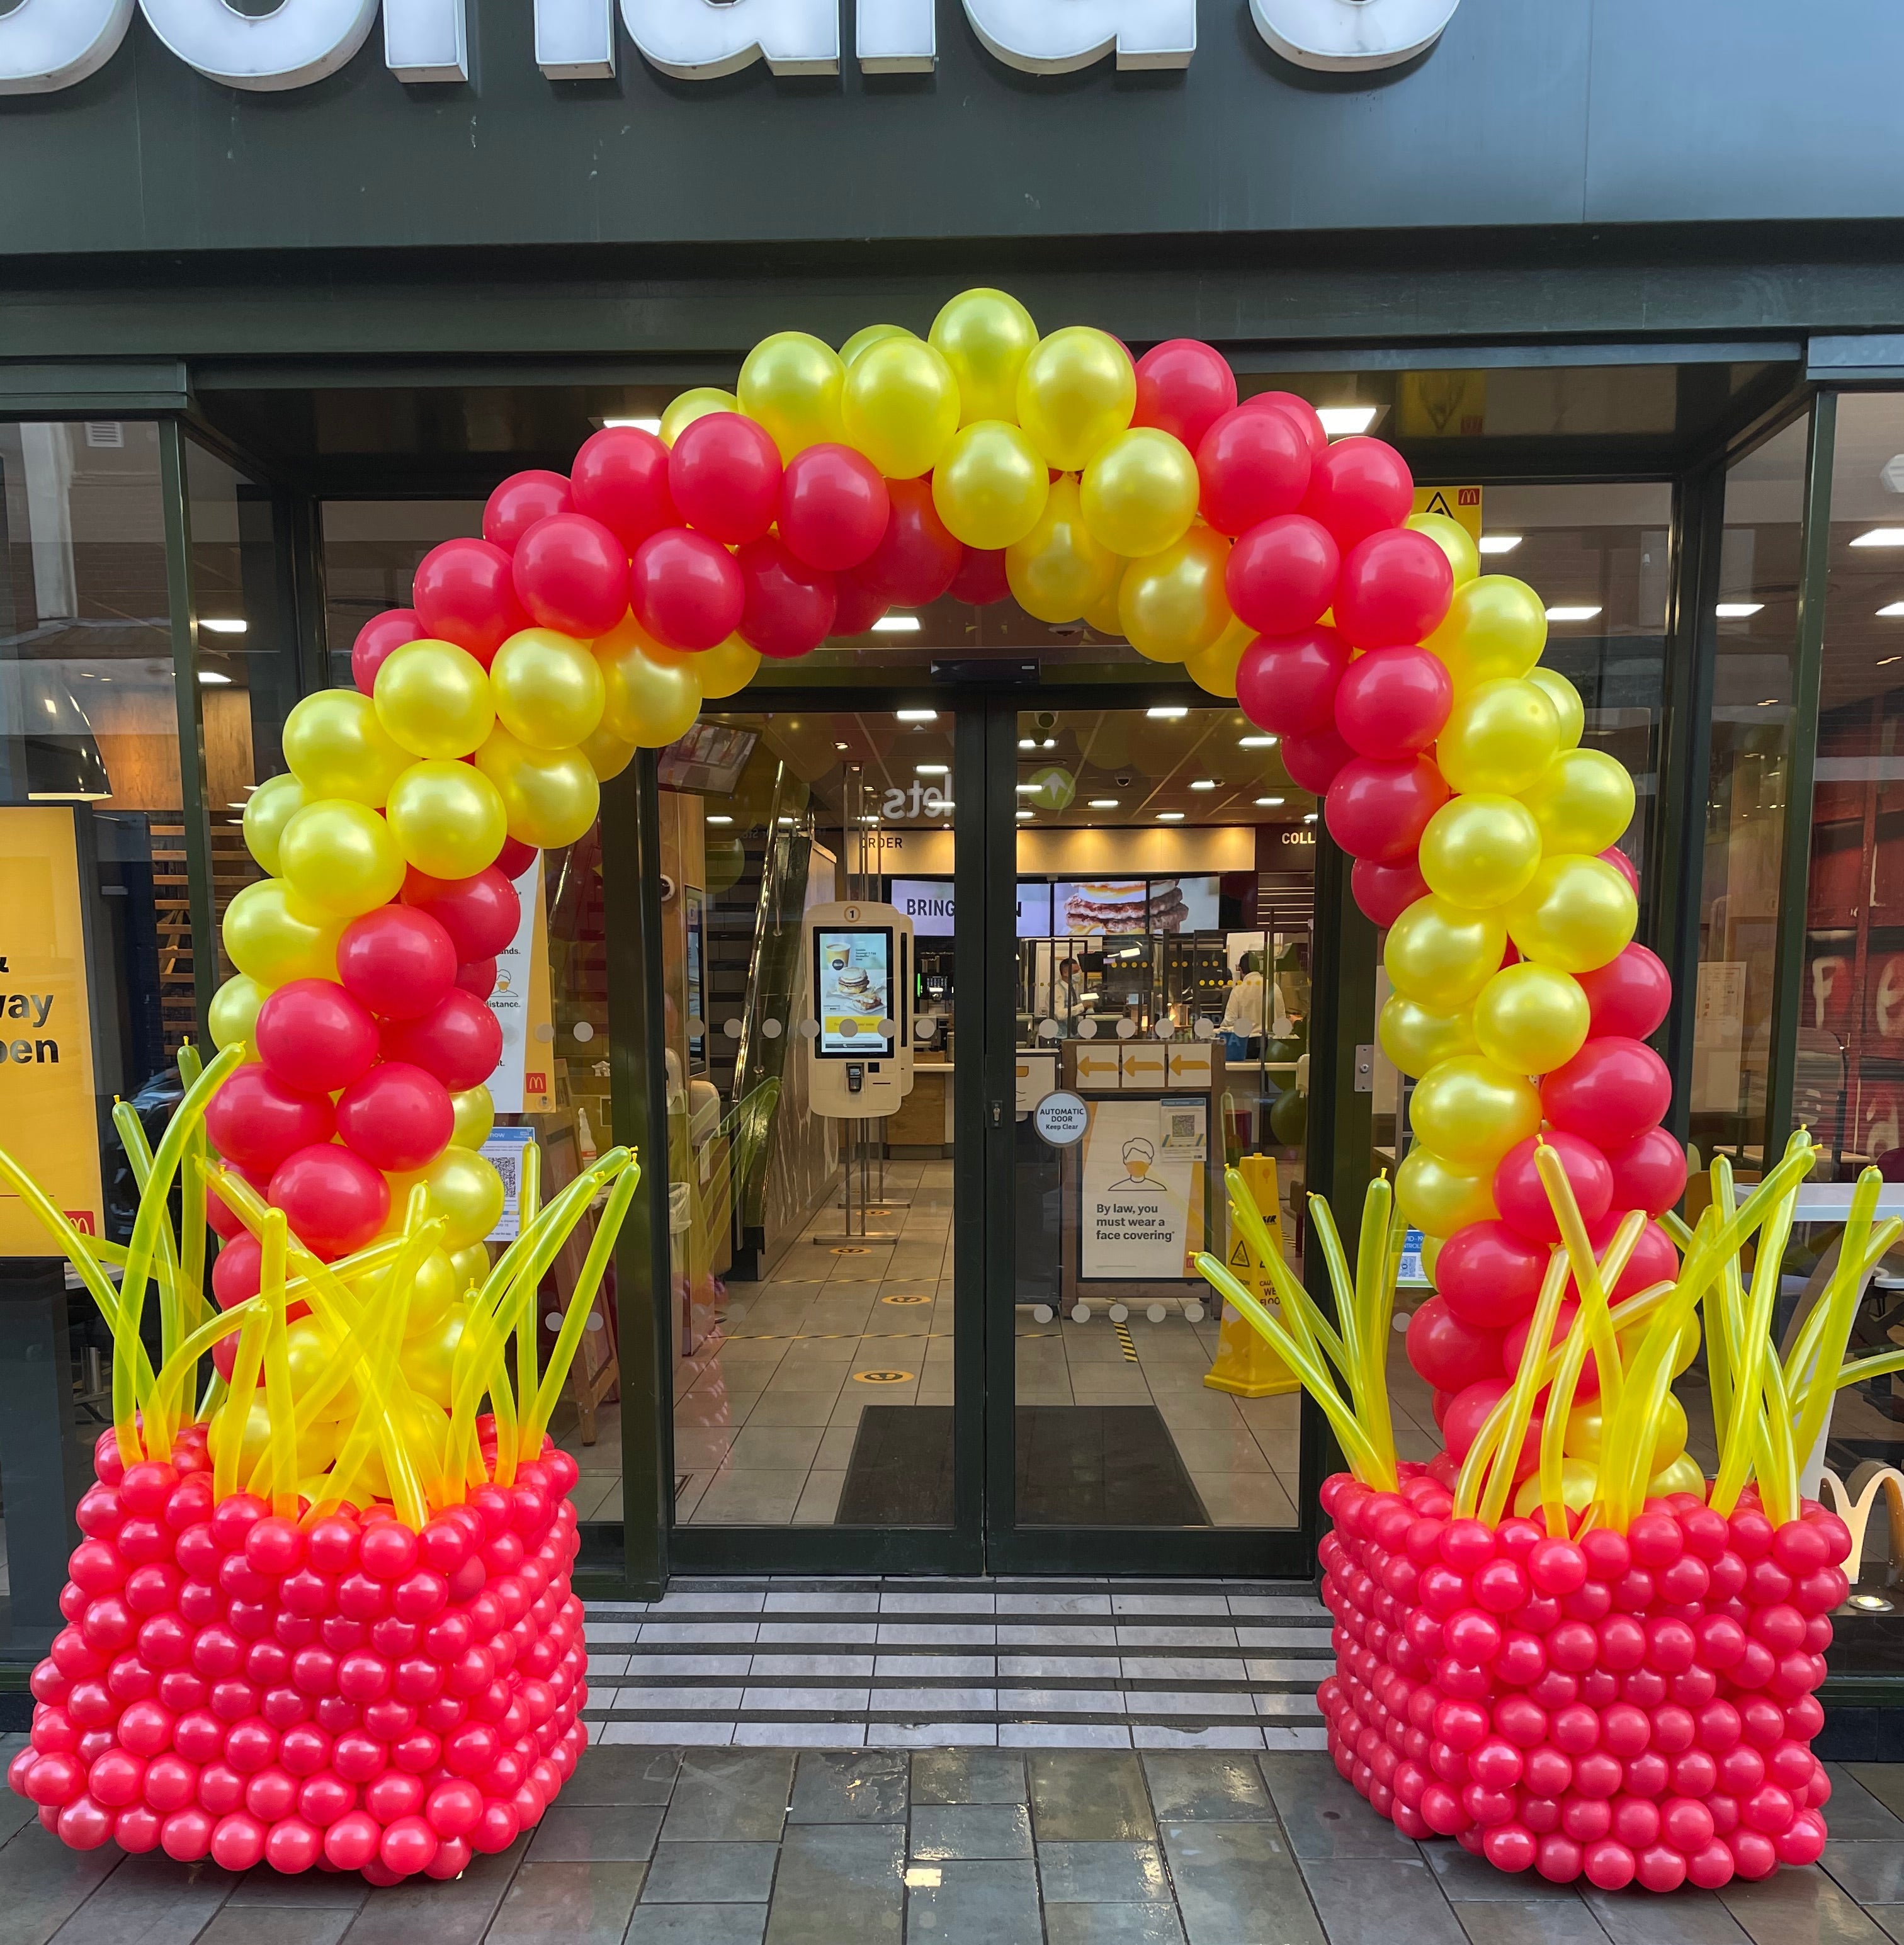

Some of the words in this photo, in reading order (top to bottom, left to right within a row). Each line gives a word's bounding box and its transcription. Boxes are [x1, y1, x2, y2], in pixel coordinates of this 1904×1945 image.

[907, 899, 955, 917] BRING
[0, 994, 54, 1028] ay
[1097, 1203, 1111, 1215] By
[1113, 1203, 1135, 1214] law,
[1138, 1205, 1158, 1215] you
[1096, 1217, 1126, 1227] must
[1096, 1230, 1121, 1240] face
